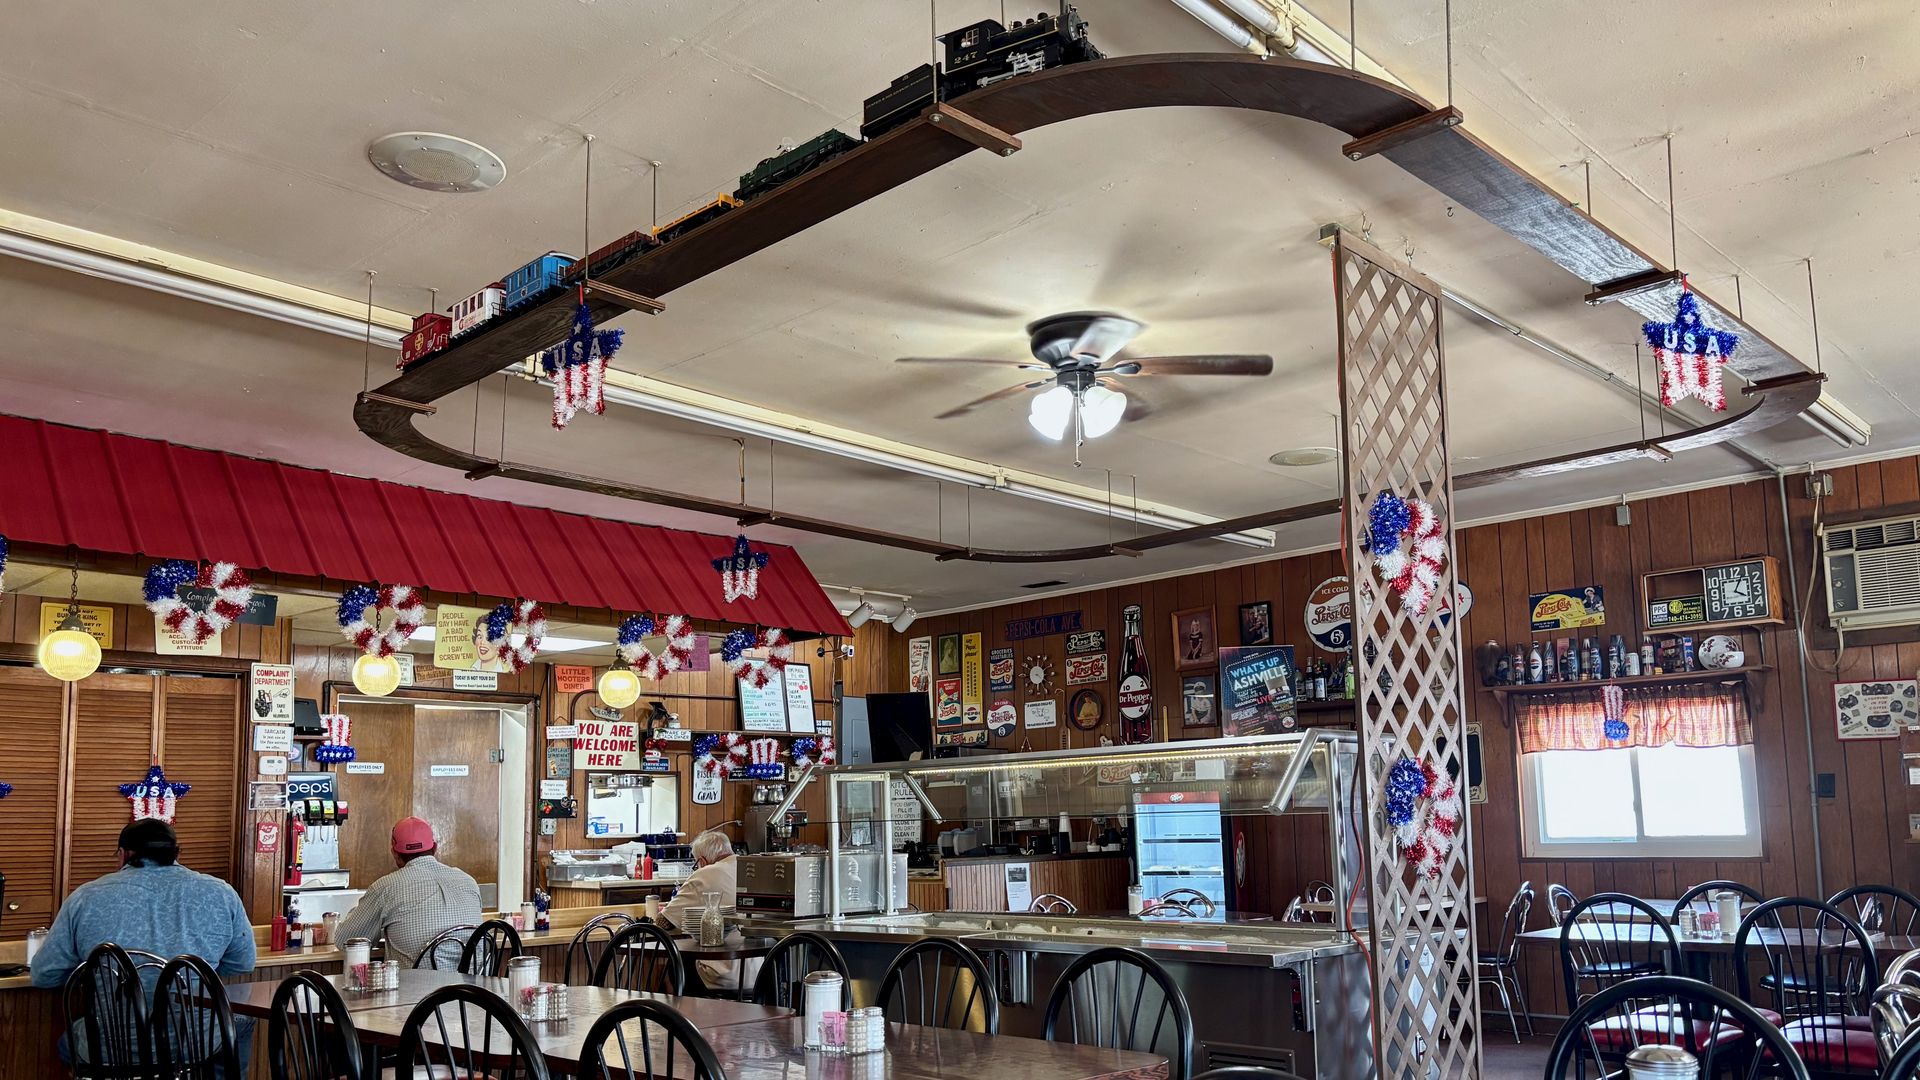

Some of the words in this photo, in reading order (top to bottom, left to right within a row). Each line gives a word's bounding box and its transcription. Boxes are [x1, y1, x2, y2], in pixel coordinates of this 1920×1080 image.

[954, 51, 978, 65] 247
[1664, 327, 1720, 355] USA
[554, 337, 601, 368] USA
[723, 557, 758, 571] USA
[1718, 568, 1726, 580] 11
[1729, 567, 1740, 579] 12
[1743, 565, 1749, 577] 1
[1752, 571, 1760, 583] 2
[1707, 576, 1719, 589] 10
[1332, 586, 1349, 594] COLD
[1710, 589, 1720, 600] 9
[1753, 583, 1762, 595] 3
[1712, 601, 1720, 612] 8
[1755, 595, 1764, 607] 4
[1654, 604, 1667, 613] PPG
[1721, 608, 1729, 619] 7
[1733, 606, 1743, 617] 6
[1746, 604, 1755, 616] 5
[1009, 617, 1056, 638] PEPSI-COLA
[561, 668, 586, 676] LITTLE
[1231, 661, 1265, 678] WHAT'S
[1267, 656, 1280, 667] UP
[256, 669, 290, 678] COMPLAINT
[1234, 664, 1288, 691] ASHVILLE
[255, 677, 291, 686] DEPARTMENT
[1127, 693, 1150, 704] Pepper
[579, 722, 604, 736] YOU
[610, 725, 634, 738] ARE
[573, 738, 638, 753] WELCOME
[587, 753, 623, 767] HERE
[136, 785, 176, 798] USA
[287, 780, 333, 796] pepsi
